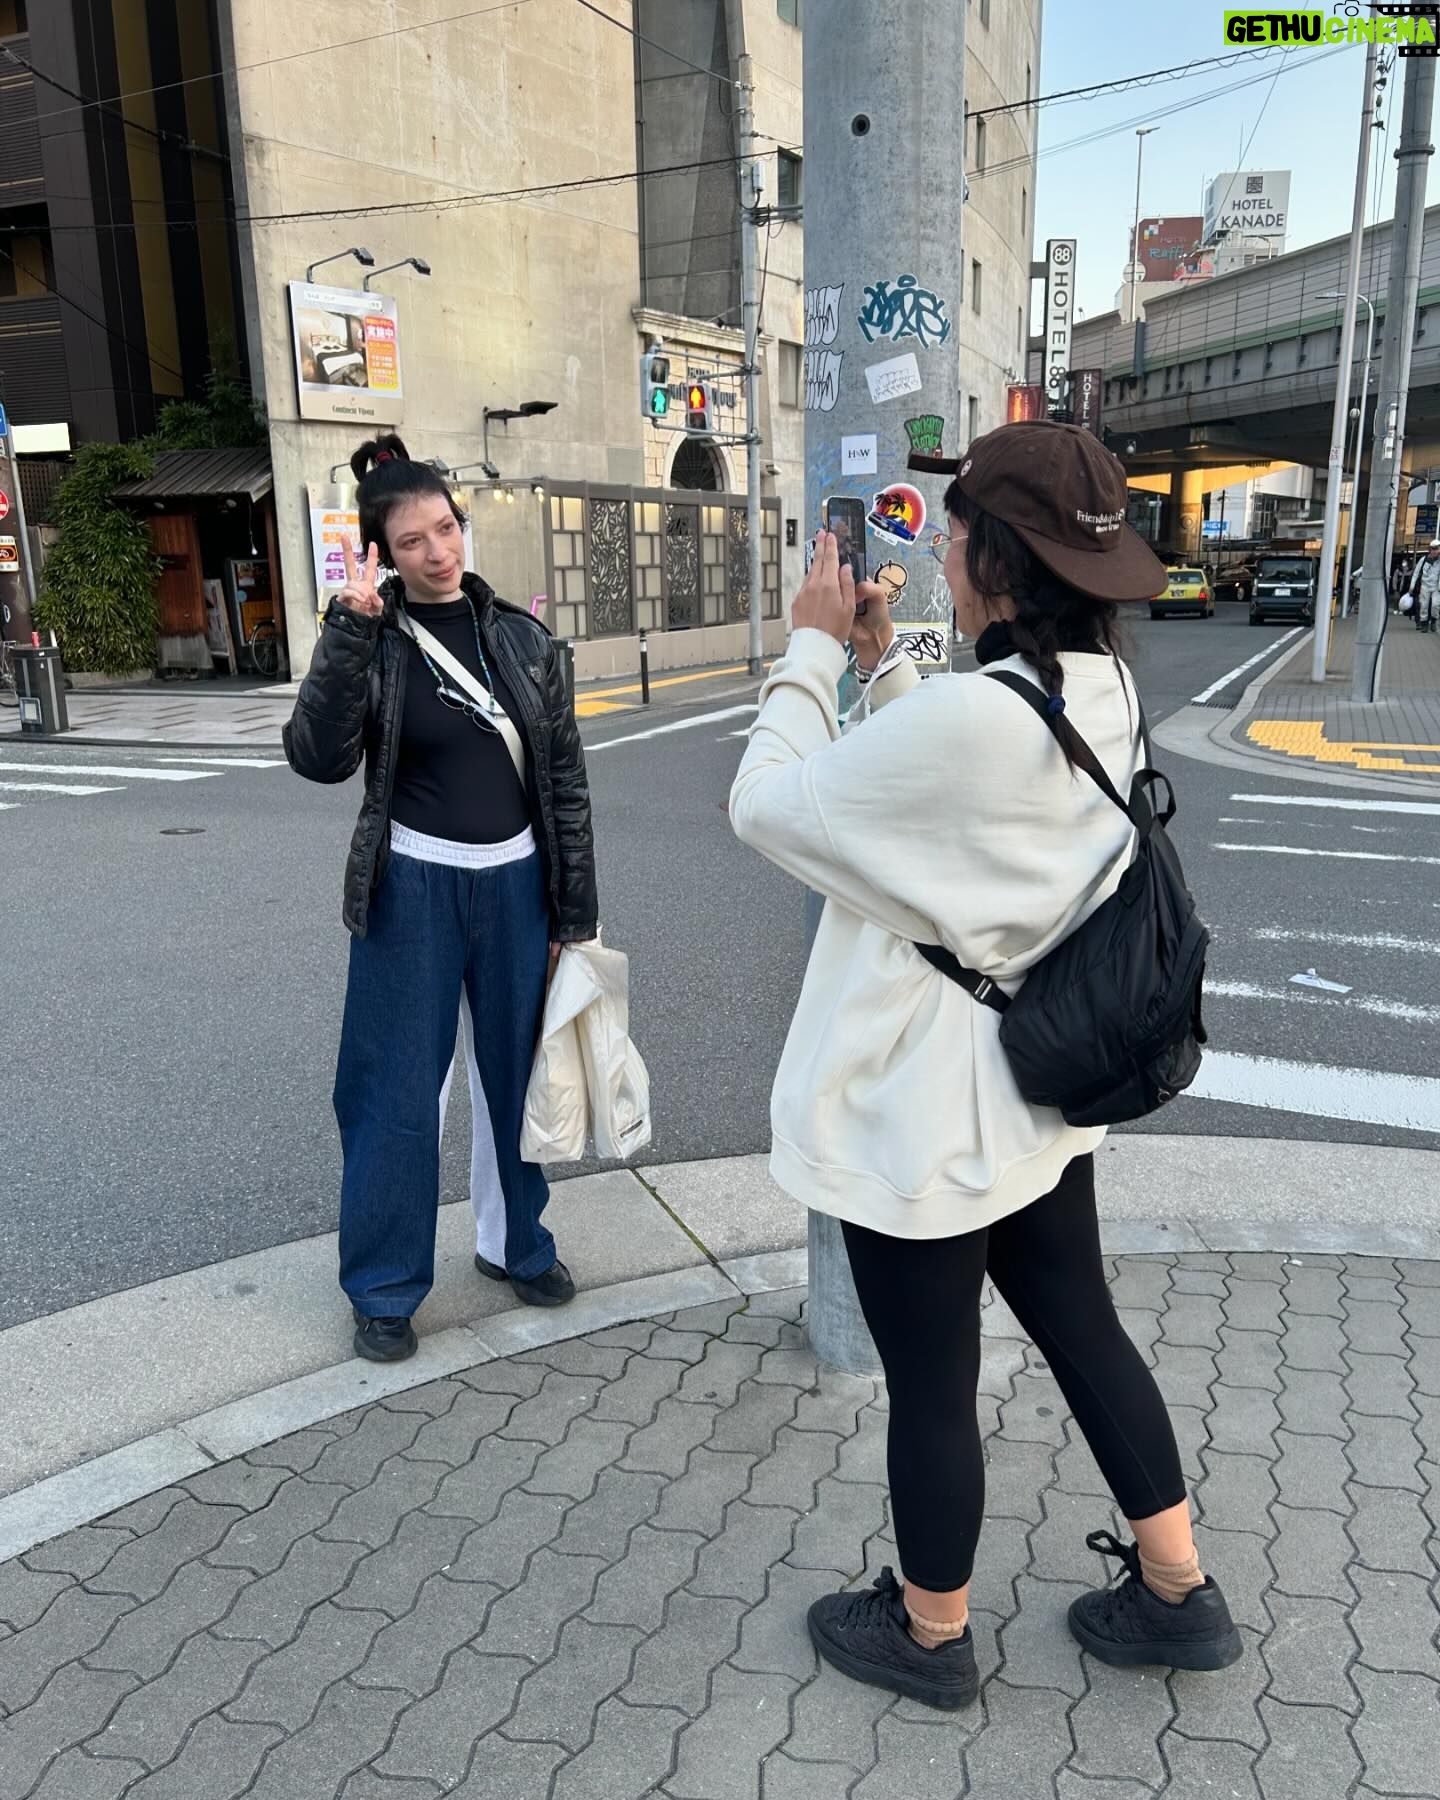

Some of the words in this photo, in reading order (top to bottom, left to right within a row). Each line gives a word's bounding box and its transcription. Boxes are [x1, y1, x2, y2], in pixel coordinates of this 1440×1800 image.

[1232, 198, 1273, 210] HOTEL
[1221, 214, 1284, 228] KANADE
[1054, 246, 1071, 263] 88
[1082, 373, 1092, 419] HOTEL
